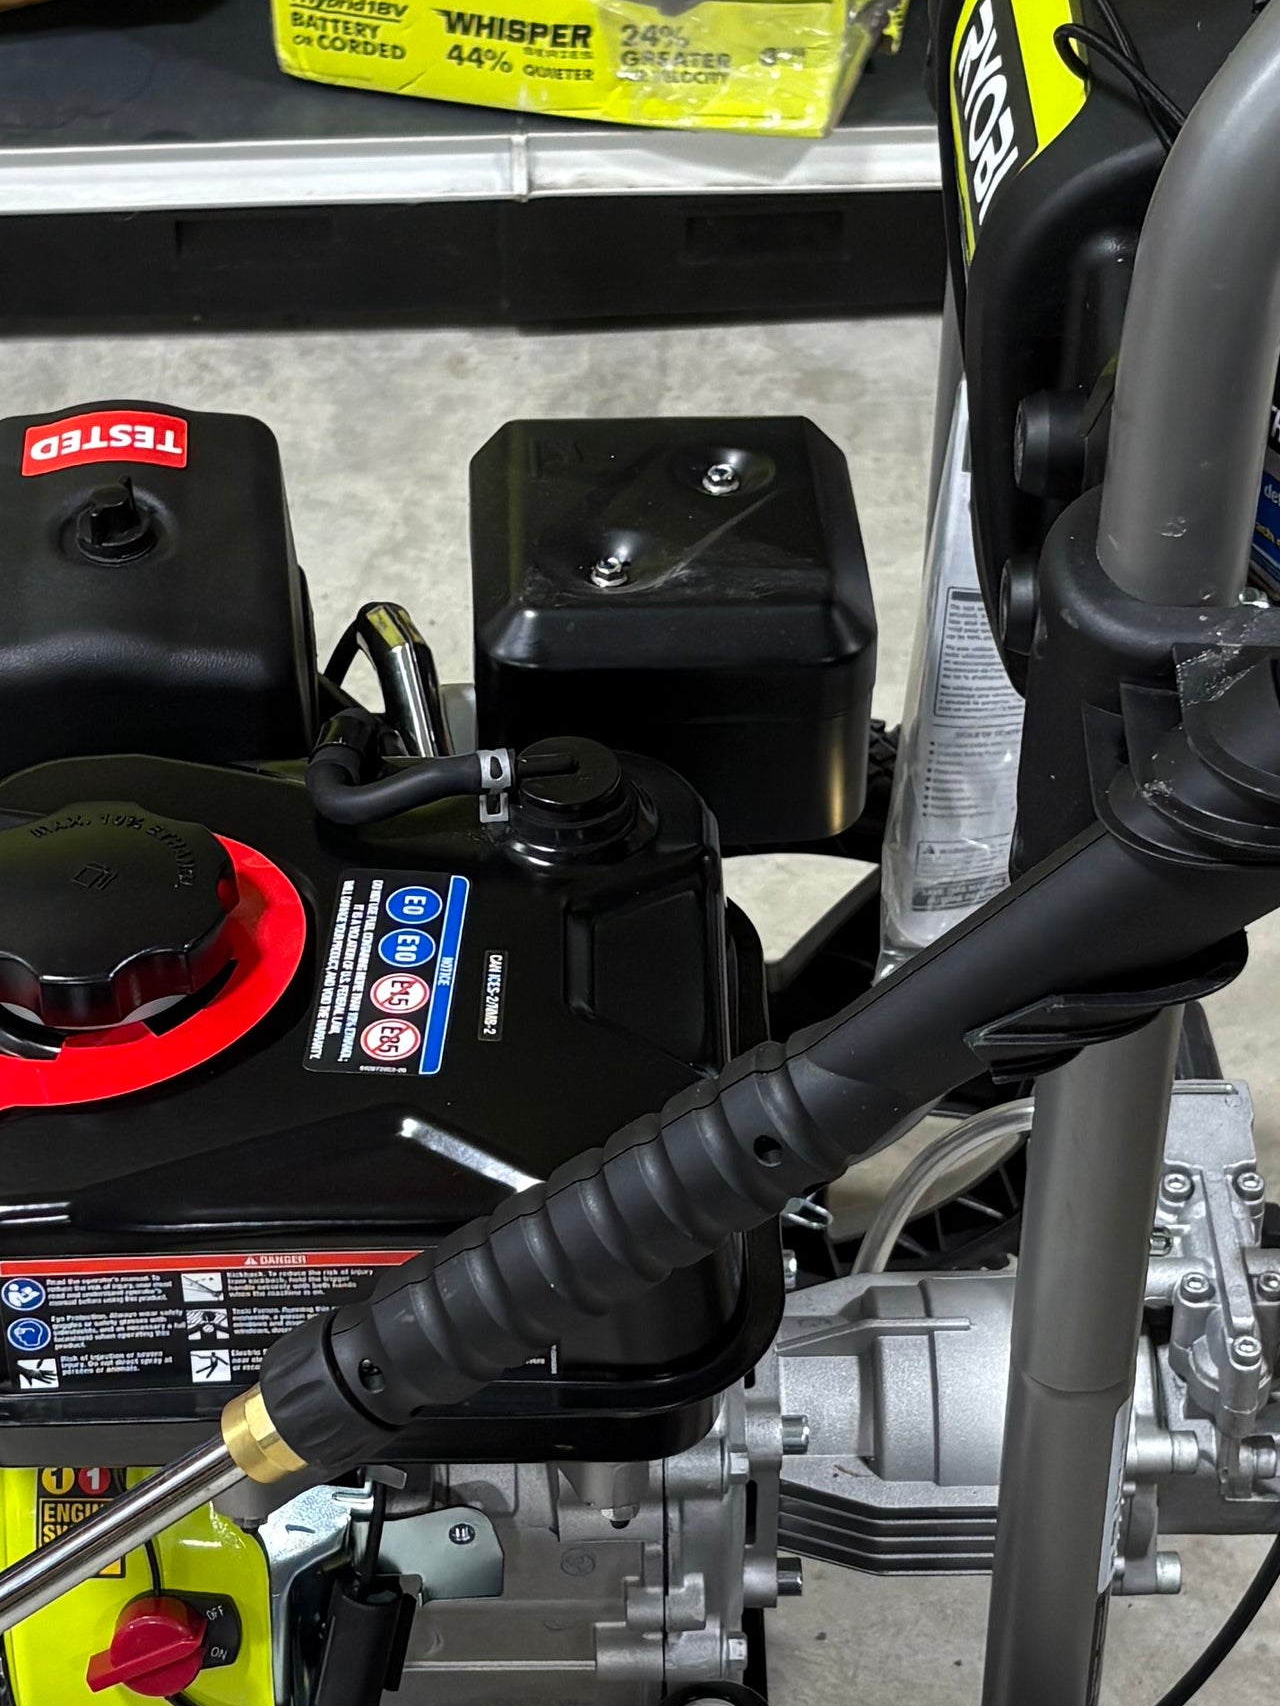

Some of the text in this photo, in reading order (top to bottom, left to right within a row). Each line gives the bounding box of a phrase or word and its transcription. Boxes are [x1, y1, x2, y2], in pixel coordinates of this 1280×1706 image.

[290, 11, 381, 39] BATTERY
[432, 8, 593, 49] WHISPER
[621, 24, 689, 48] 24%
[316, 36, 407, 60] CORDED
[523, 46, 594, 59] SERIES
[621, 50, 732, 69] GREATER
[447, 44, 594, 82] 44% QUIETER
[30, 424, 183, 462] TESTED
[403, 894, 427, 917] E0
[394, 934, 420, 963] E10
[437, 956, 455, 987] NOTICE
[388, 979, 410, 1008] E15
[379, 1024, 402, 1054] E85
[259, 1255, 306, 1265] DANGER
[206, 1604, 224, 1621] OFF
[210, 1646, 228, 1661] ON
